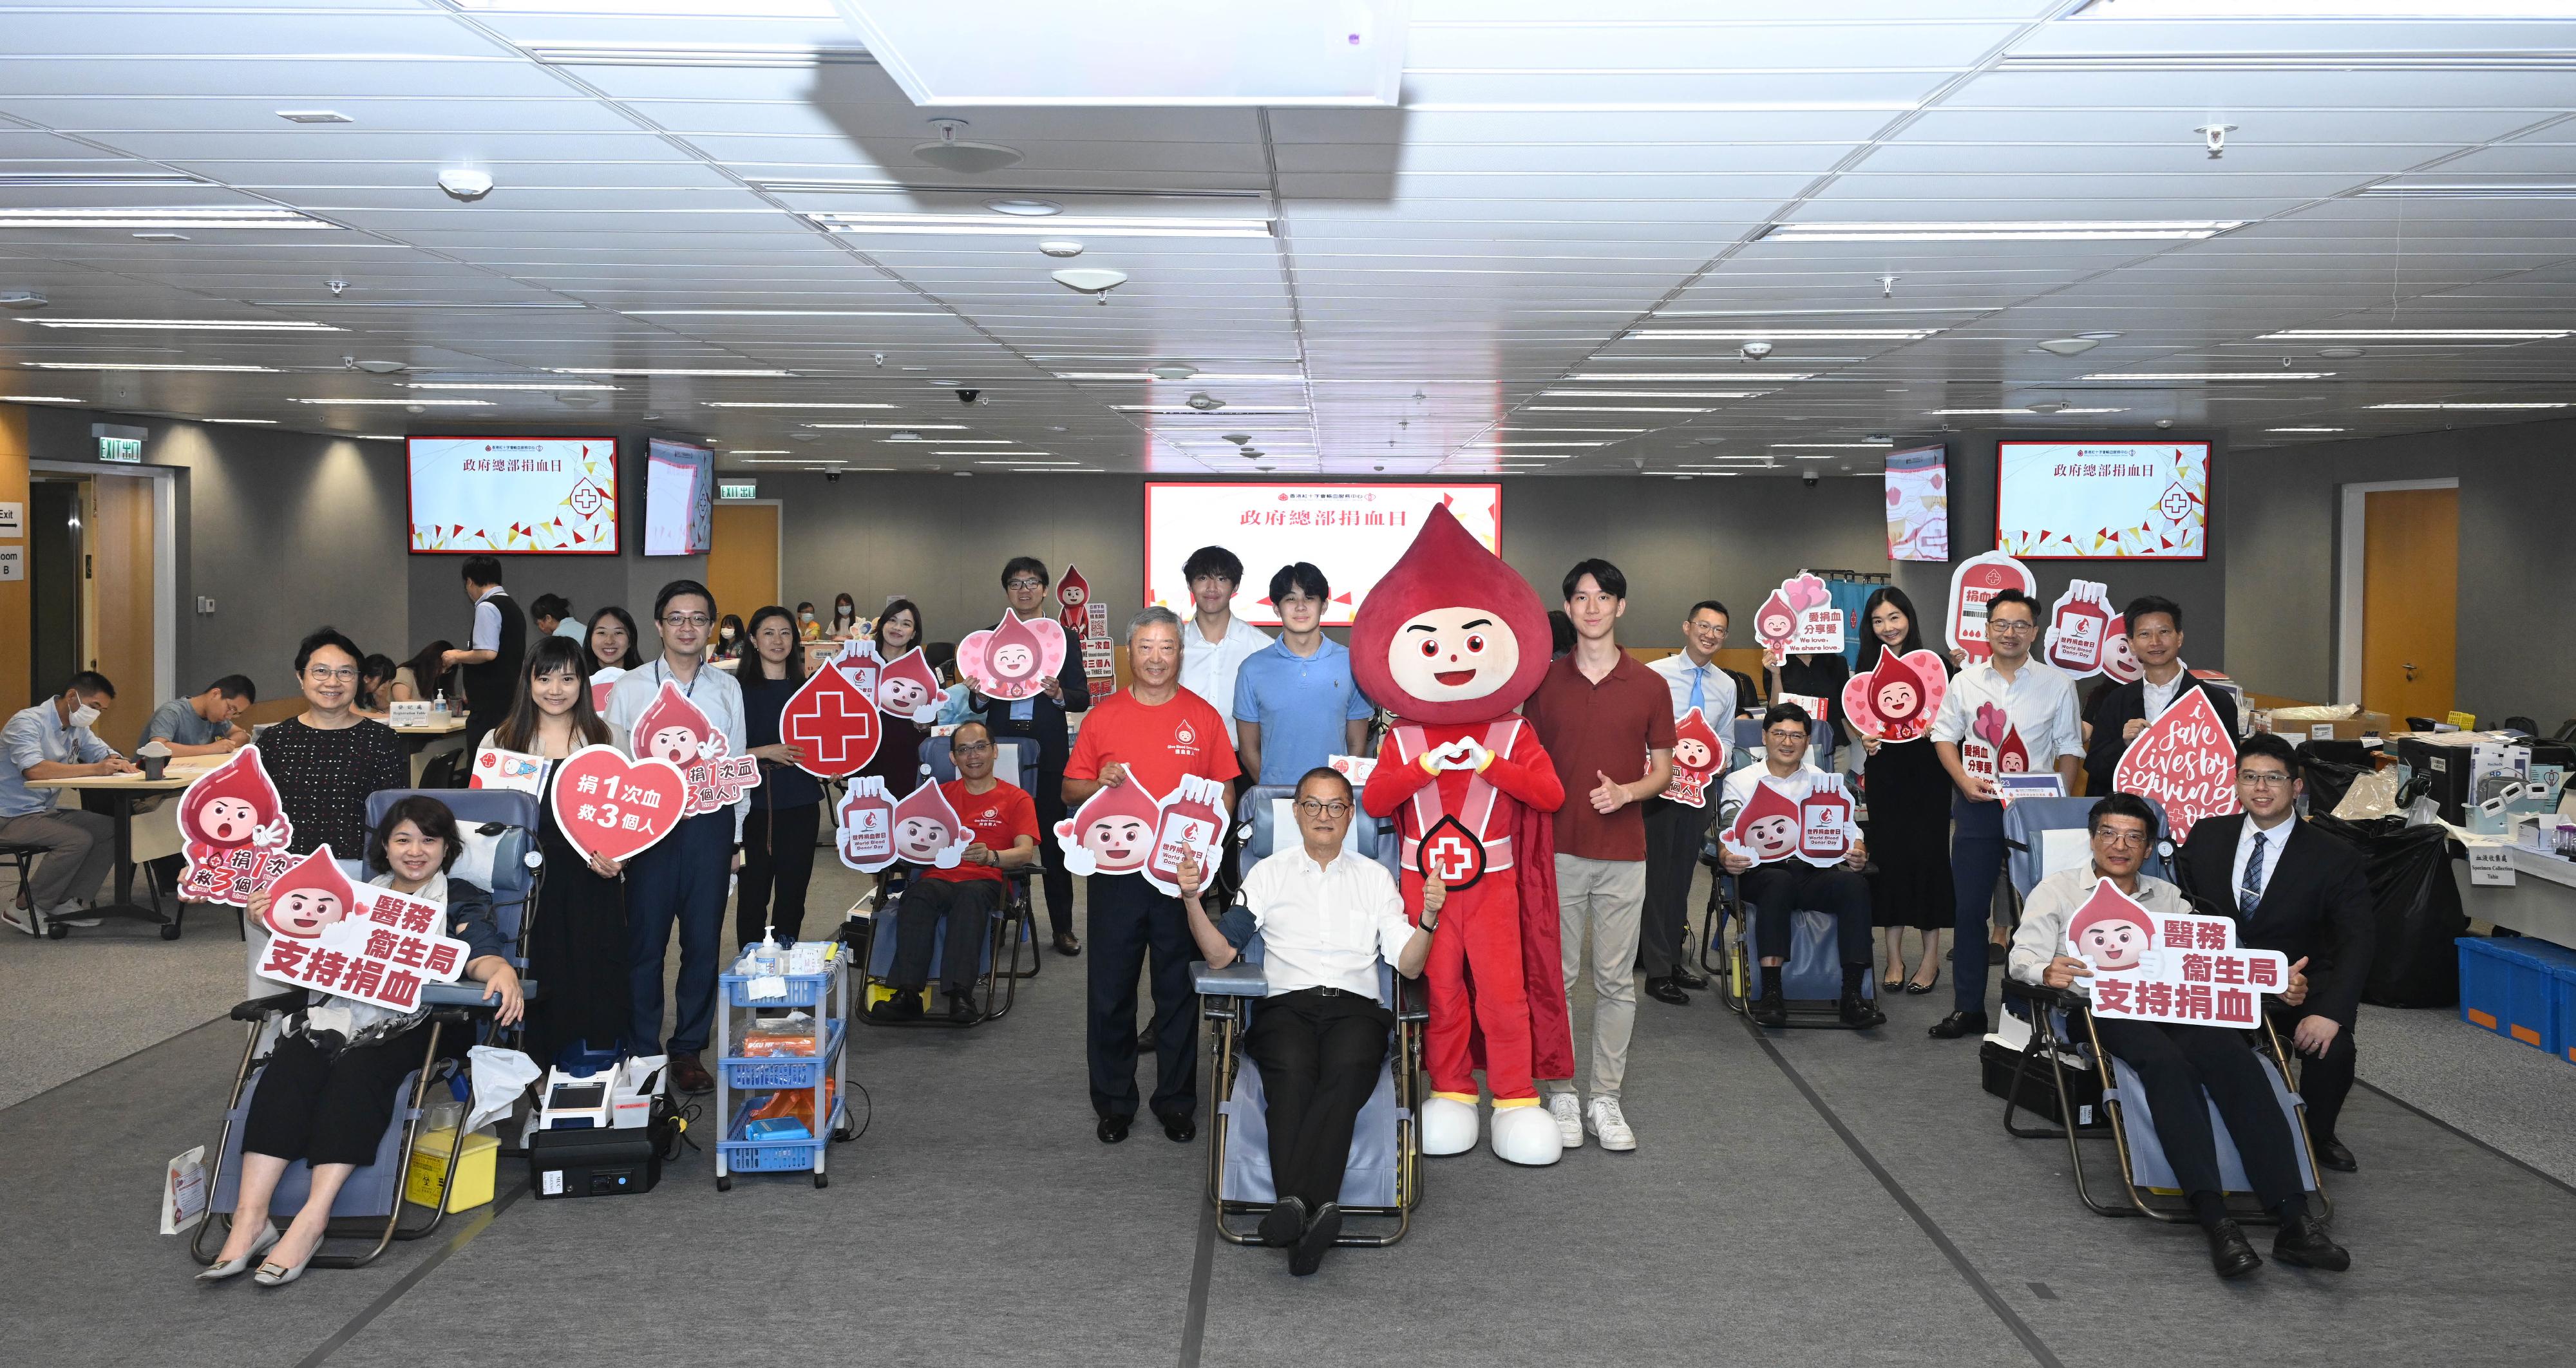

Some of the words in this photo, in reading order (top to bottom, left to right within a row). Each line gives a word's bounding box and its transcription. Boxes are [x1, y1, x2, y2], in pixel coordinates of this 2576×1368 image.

[100, 439, 121, 459] EXIT
[122, 440, 139, 460] 出口
[463, 458, 562, 472] 政府總部捐血日
[2054, 464, 2154, 477] 政府總部捐血日
[722, 486, 738, 498] EXIT
[740, 486, 755, 498] 出口
[1240, 509, 1406, 526] 政府總部捐血日
[3, 566, 10, 574] B
[1808, 612, 1841, 623] 愛捐血
[1804, 624, 1837, 635] 分享愛
[2061, 637, 2095, 648] 世界捐血者日
[1088, 679, 1112, 696] 隊長
[2190, 700, 2206, 719] i
[1964, 744, 1988, 758] 愛捐血
[690, 761, 753, 787] 捐1次血
[1968, 760, 1992, 774] 分享愛
[576, 774, 662, 809] 捐1次血
[2122, 771, 2239, 816] giving
[577, 803, 654, 836] 救3個人
[1162, 843, 1203, 859] 世界捐者日
[1163, 852, 1180, 861] World
[232, 849, 299, 879] 捐1次
[1163, 858, 1179, 867] Dono
[368, 894, 437, 935] 醫務
[2163, 919, 2226, 951] 醫務
[263, 938, 422, 1008] 支持捐血
[2095, 977, 2254, 1023] 支持捐血
